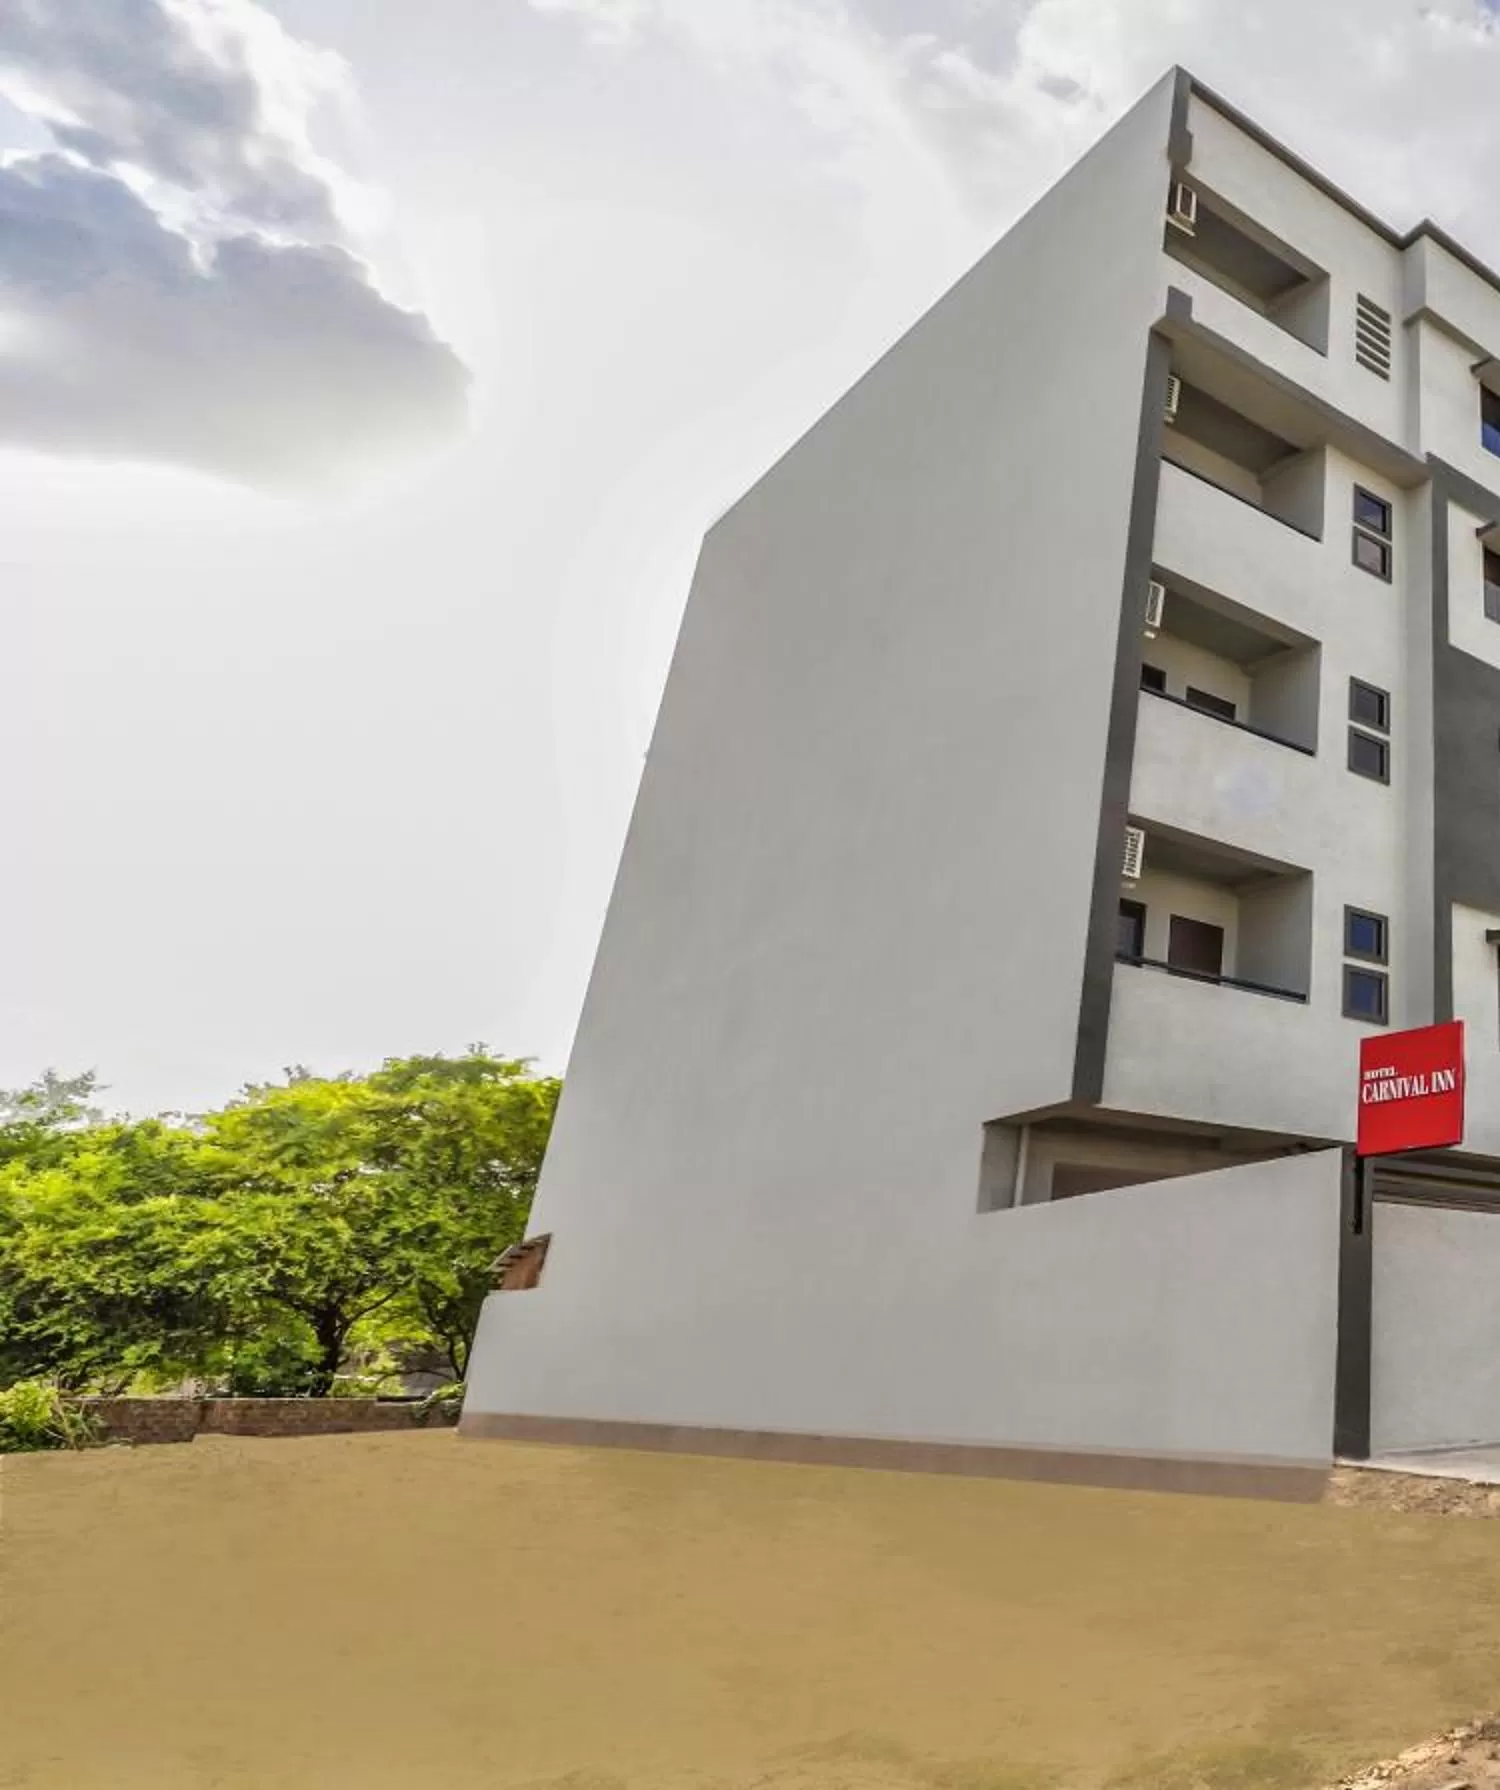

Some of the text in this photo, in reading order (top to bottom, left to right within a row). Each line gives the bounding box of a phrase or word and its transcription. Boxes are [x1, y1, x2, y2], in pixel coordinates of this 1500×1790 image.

[1364, 1066, 1398, 1080] HOTEL
[1362, 1068, 1456, 1104] CARNIVAL INN
